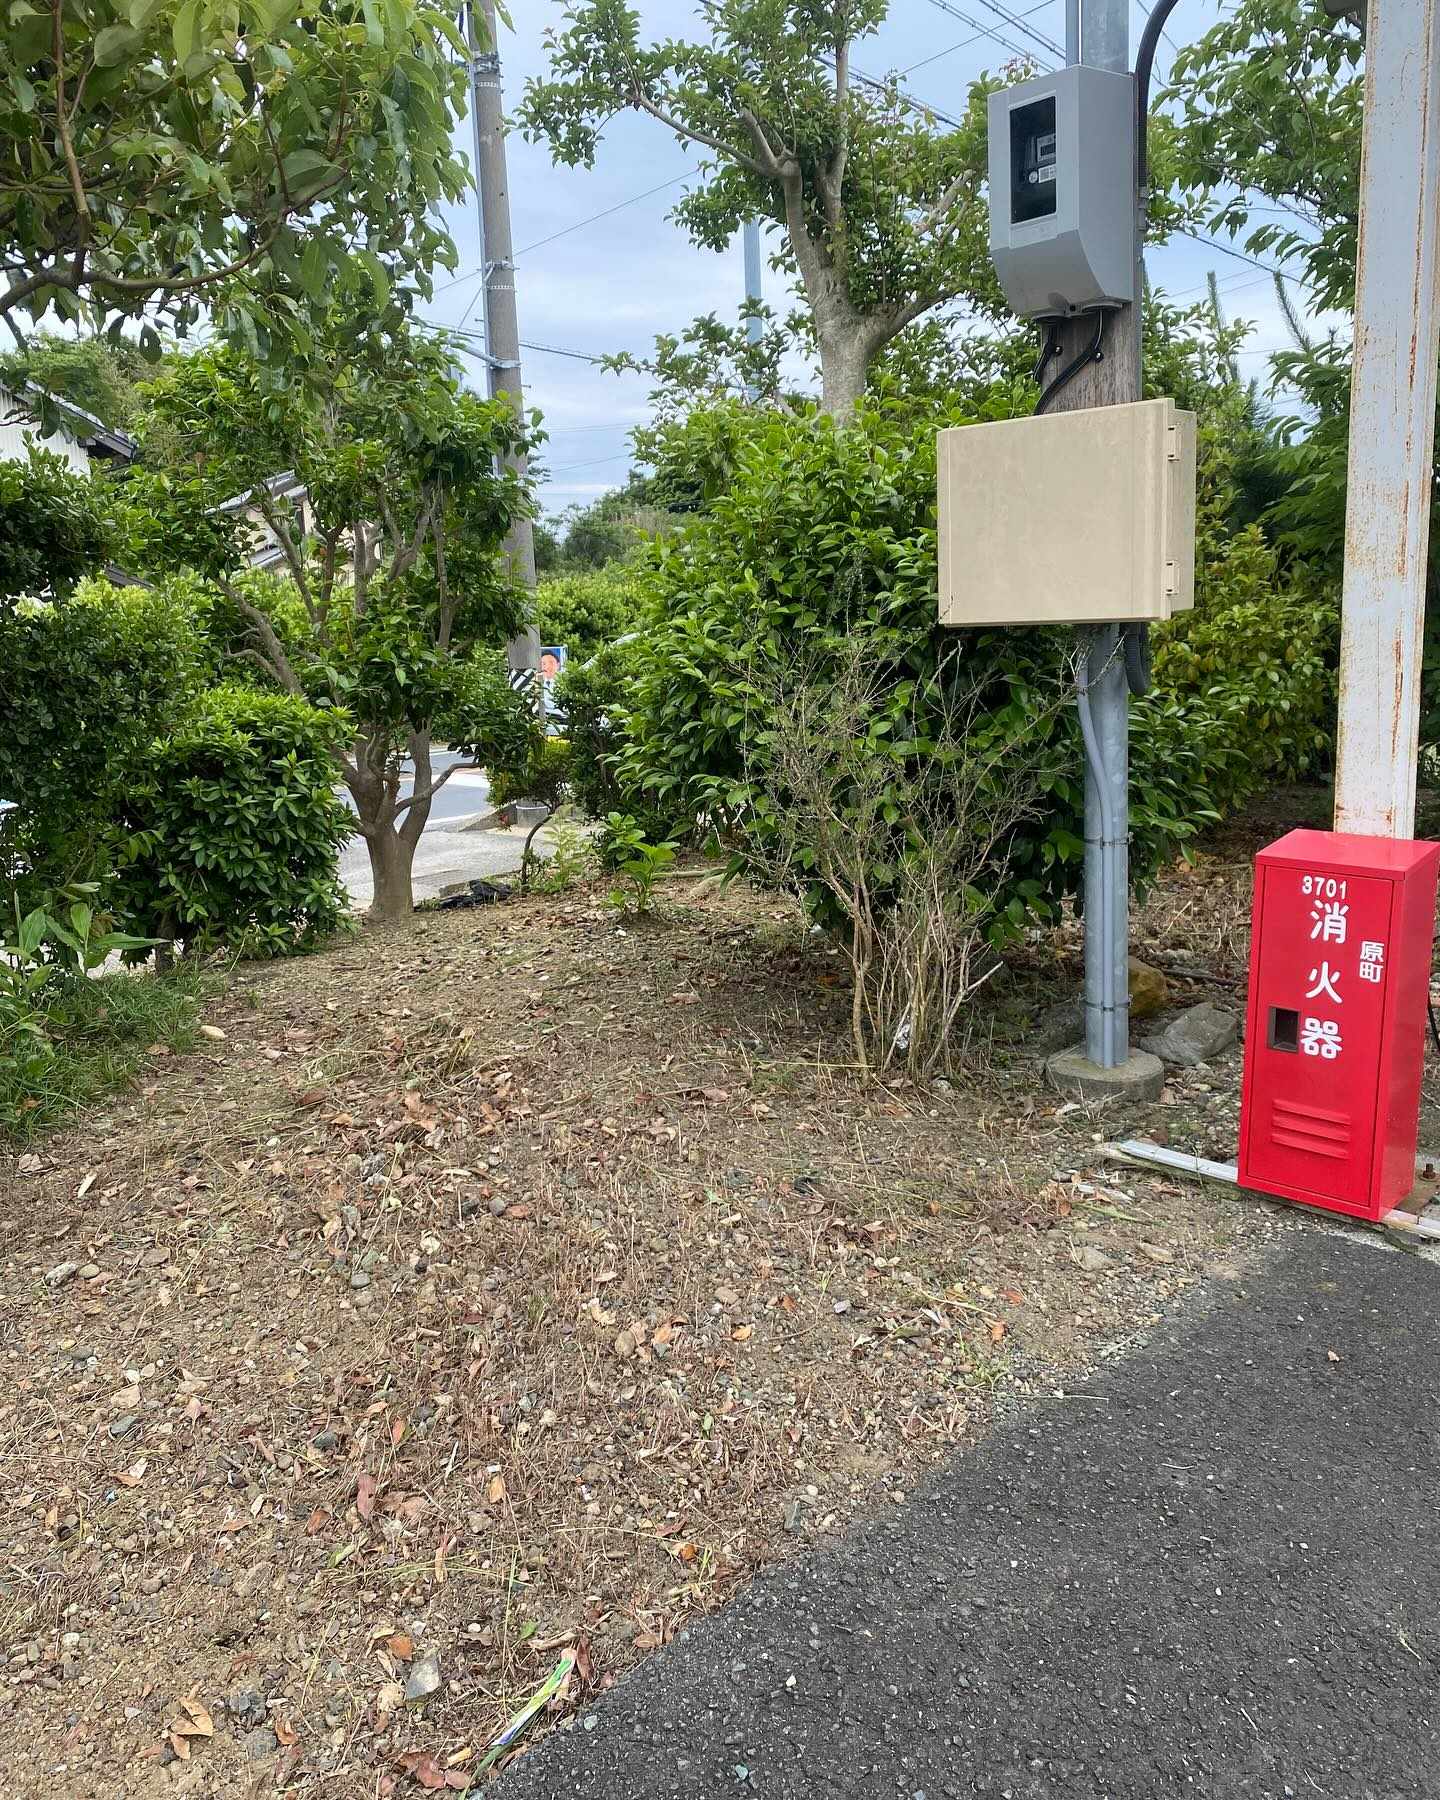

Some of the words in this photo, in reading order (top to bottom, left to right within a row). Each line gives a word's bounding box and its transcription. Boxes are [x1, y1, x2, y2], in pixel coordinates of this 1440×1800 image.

[1302, 875, 1348, 900] 3701
[1300, 899, 1349, 1059] 消火器
[1359, 940, 1385, 984] 原町
